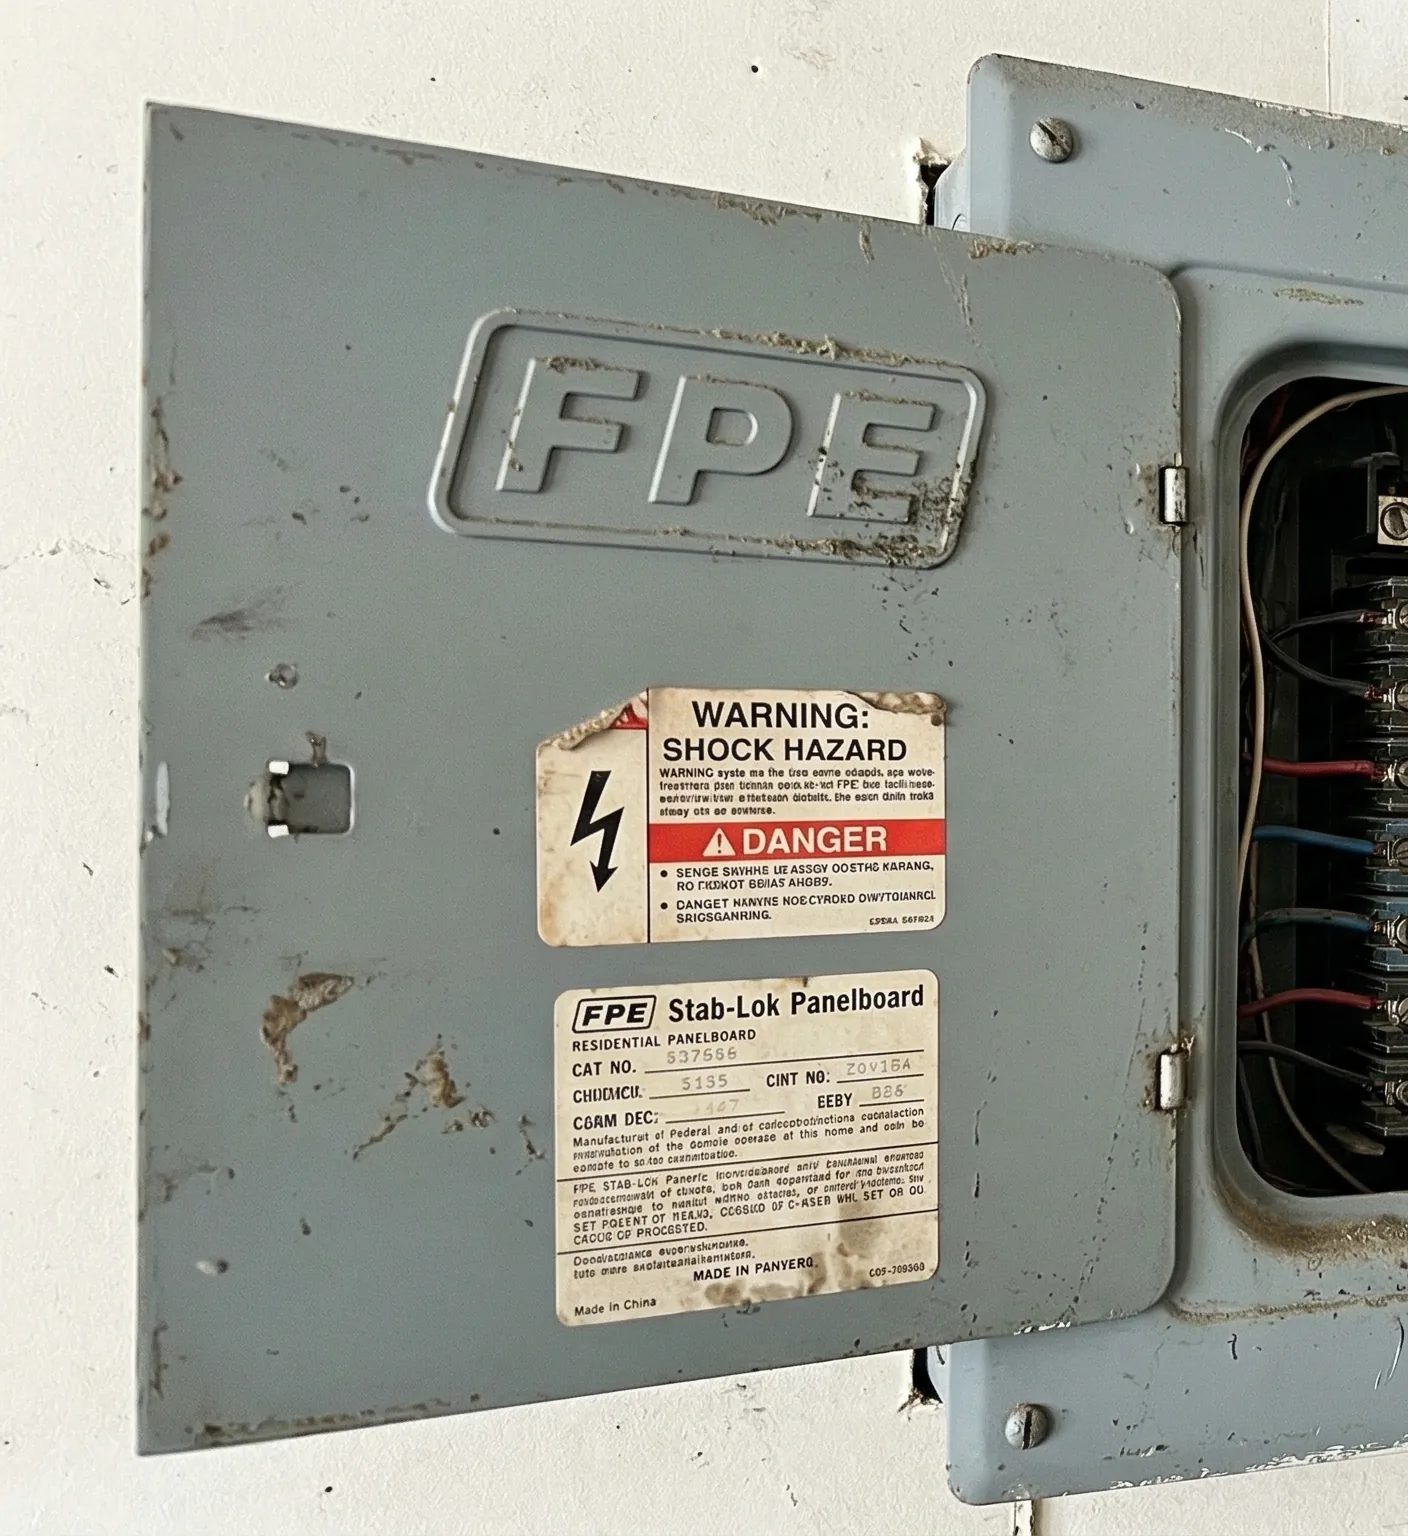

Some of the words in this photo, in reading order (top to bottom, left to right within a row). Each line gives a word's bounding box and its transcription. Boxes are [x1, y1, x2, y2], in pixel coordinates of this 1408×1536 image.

[496, 356, 938, 525] FPE
[692, 701, 869, 729] WARNING:
[663, 738, 775, 762] SHOCK
[784, 738, 907, 761] HAZARD
[742, 827, 888, 854] DANGER
[676, 867, 719, 878] SENGE
[677, 881, 694, 891] RO
[582, 1003, 650, 1027] FPE
[668, 993, 781, 1022] Stab-Lok
[791, 984, 924, 1016] Panelboard
[572, 1036, 661, 1051] RESIDENTIAL
[668, 1029, 757, 1046] PANELBOARD
[572, 1061, 602, 1077] CAT
[610, 1059, 637, 1075] NO.
[766, 1072, 798, 1087] CINT
[666, 1140, 683, 1151] the
[800, 1128, 818, 1139] this
[860, 1122, 878, 1133] and
[619, 1158, 630, 1168] to
[573, 1220, 597, 1234] SET
[863, 1190, 884, 1201] SET
[652, 1202, 664, 1213] to
[693, 1267, 731, 1282] MADE
[735, 1264, 749, 1276] IN
[574, 1303, 605, 1317] Made
[609, 1301, 620, 1312] in
[623, 1297, 657, 1311] China
